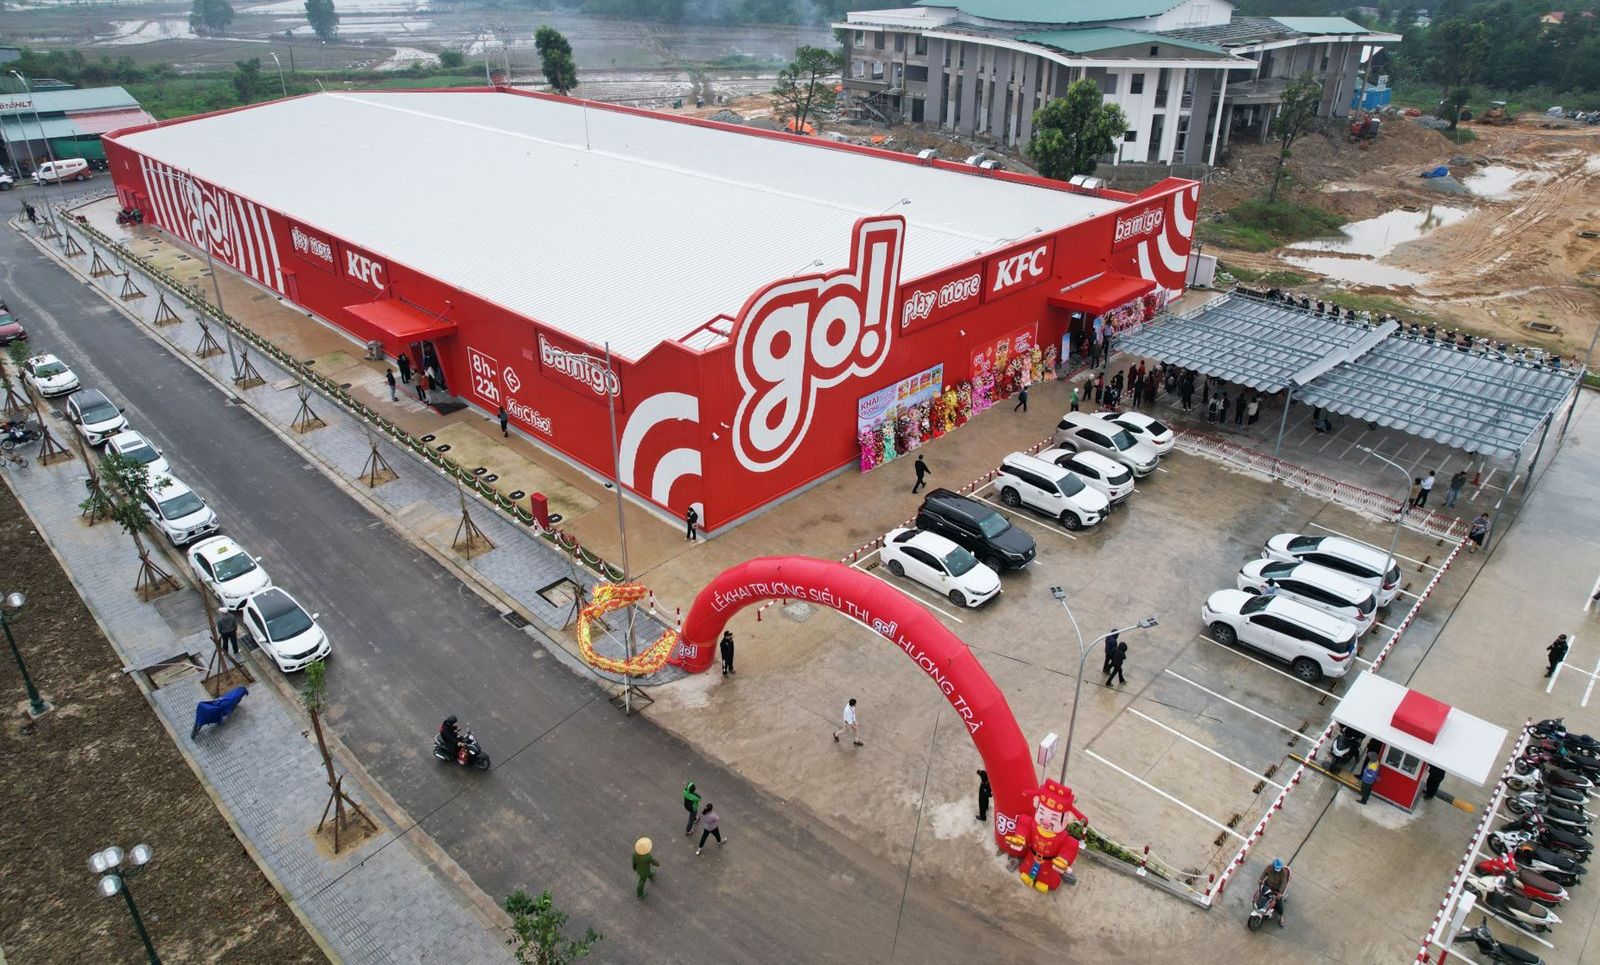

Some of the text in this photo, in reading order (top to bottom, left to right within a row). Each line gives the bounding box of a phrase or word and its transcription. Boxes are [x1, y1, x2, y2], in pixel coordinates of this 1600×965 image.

[183, 177, 236, 266] go!
[1113, 206, 1165, 243] bamigo
[346, 249, 385, 290] KFC
[993, 246, 1047, 292] KFC
[902, 273, 982, 327] play more
[538, 333, 621, 398] bamigo
[732, 219, 904, 473] go!
[475, 376, 501, 403] 22h
[722, 585, 752, 604] KHAI
[809, 587, 842, 609] SIÊU
[873, 617, 898, 639] go!
[898, 635, 955, 695] HƯƠNG
